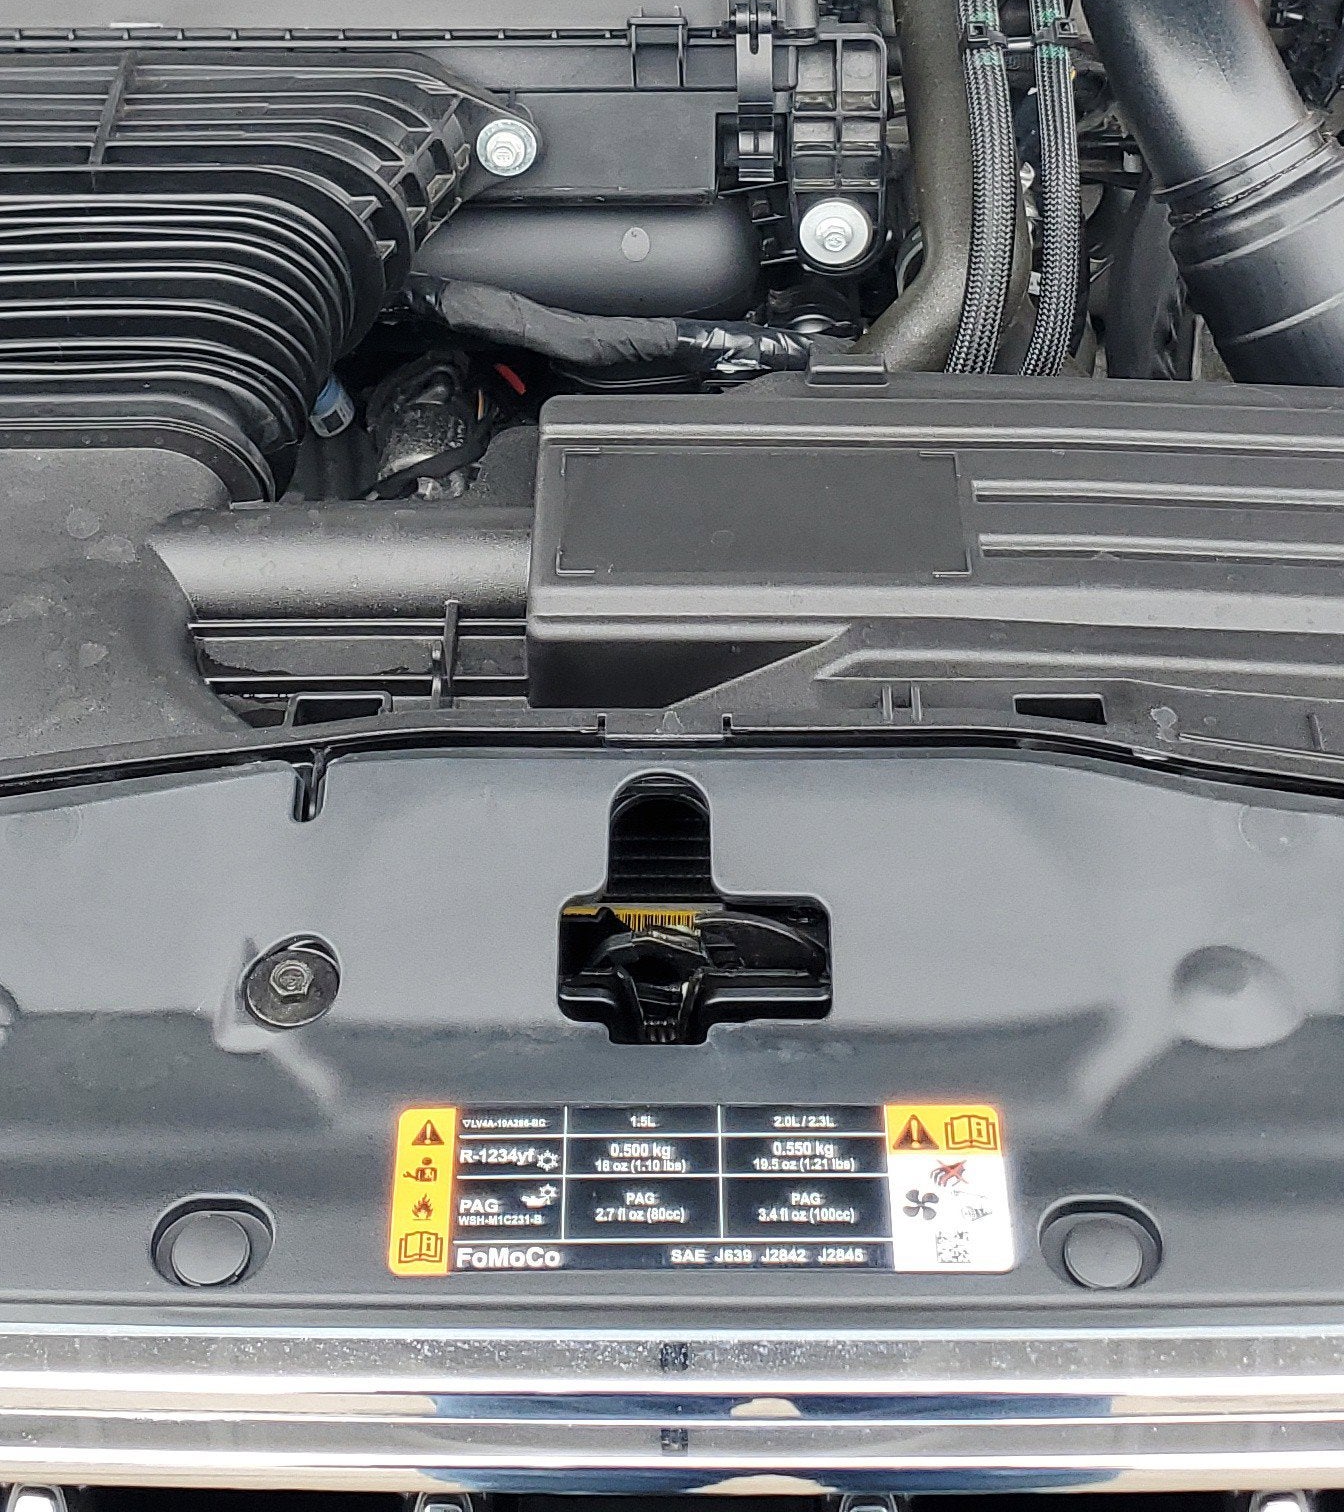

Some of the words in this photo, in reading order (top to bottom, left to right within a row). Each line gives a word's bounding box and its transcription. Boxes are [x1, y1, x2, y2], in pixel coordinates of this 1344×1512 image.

[630, 1115, 657, 1128] 1.5L
[773, 1116, 800, 1128] 2.0L
[807, 1115, 835, 1128] 2.3L
[459, 1147, 536, 1166] R-1234yf
[610, 1143, 649, 1158] 0.500
[652, 1142, 672, 1160] kg
[772, 1141, 812, 1156] 0.550
[815, 1140, 834, 1158] kg
[595, 1159, 610, 1172] 18
[613, 1161, 629, 1171] oz
[631, 1159, 661, 1173] (1.10
[663, 1159, 687, 1174] lbs)
[753, 1158, 779, 1171] 19.5
[781, 1160, 798, 1170] oz
[799, 1158, 828, 1172] (1.21
[832, 1158, 856, 1172] lbs)
[459, 1198, 500, 1214] PAG
[626, 1192, 657, 1206] PAG
[791, 1192, 822, 1206] PAG
[458, 1214, 544, 1226] WSH-M1C231-B
[594, 1208, 615, 1221] 2.7
[617, 1207, 626, 1221] fl
[628, 1210, 645, 1221] oz
[646, 1207, 686, 1224] (80cc)
[758, 1208, 778, 1222] 3.4
[779, 1207, 789, 1222] fl
[791, 1211, 808, 1222] oz
[809, 1207, 856, 1224] (100cc)
[456, 1246, 561, 1269] FoMoCo
[670, 1249, 707, 1263] SAE
[714, 1247, 753, 1263] J639
[760, 1247, 807, 1263] J2842
